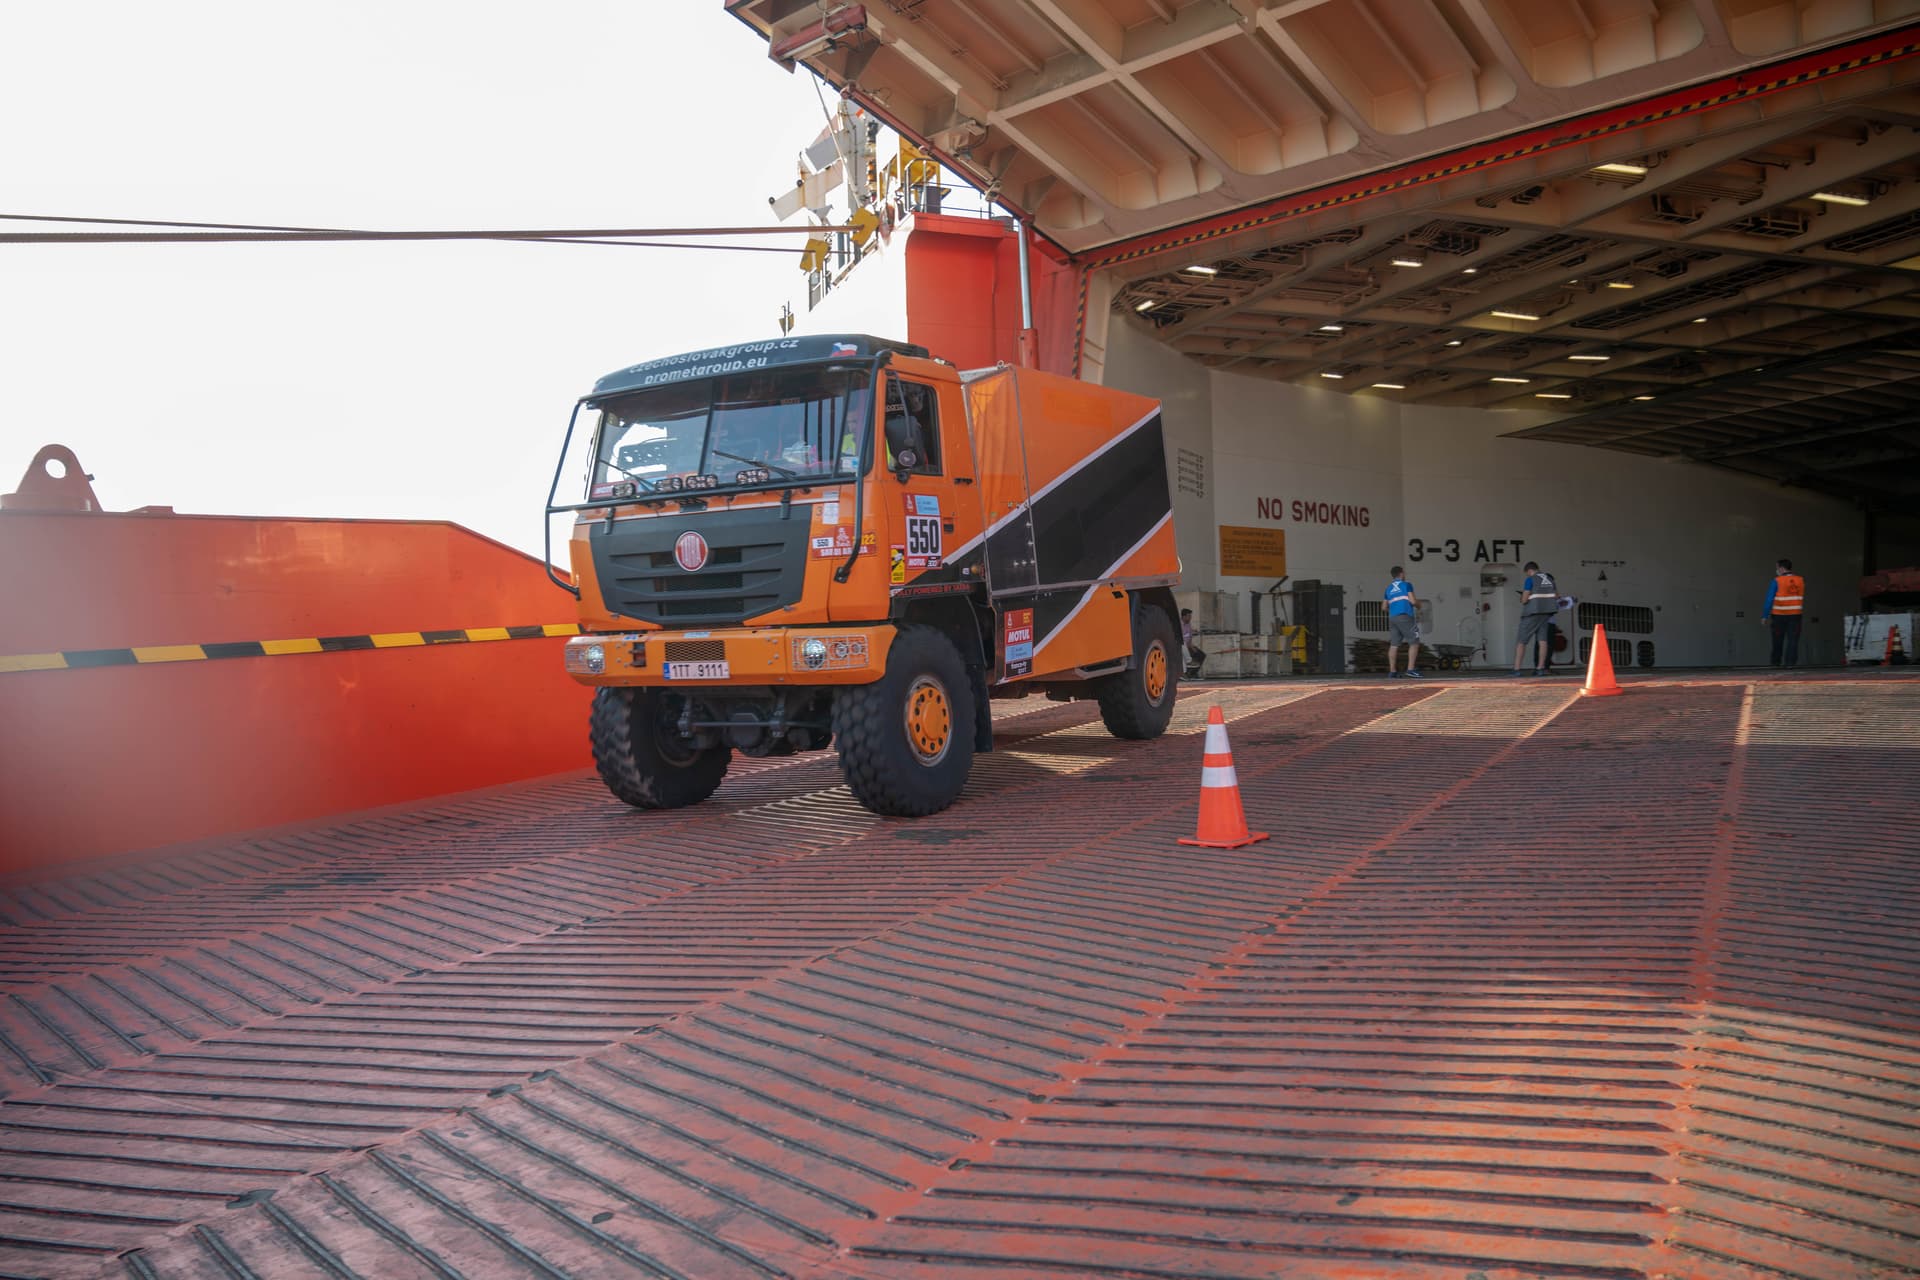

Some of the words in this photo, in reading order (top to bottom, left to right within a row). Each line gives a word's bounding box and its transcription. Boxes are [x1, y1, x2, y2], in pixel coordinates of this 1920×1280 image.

[1257, 497, 1282, 520] NO
[1292, 500, 1370, 527] SMOKING
[909, 518, 940, 554] 550
[1408, 538, 1460, 562] 3-3
[1473, 539, 1525, 562] AFT
[1007, 628, 1030, 644] MOTUL
[672, 664, 690, 678] 1TT
[698, 663, 724, 678] 9111
